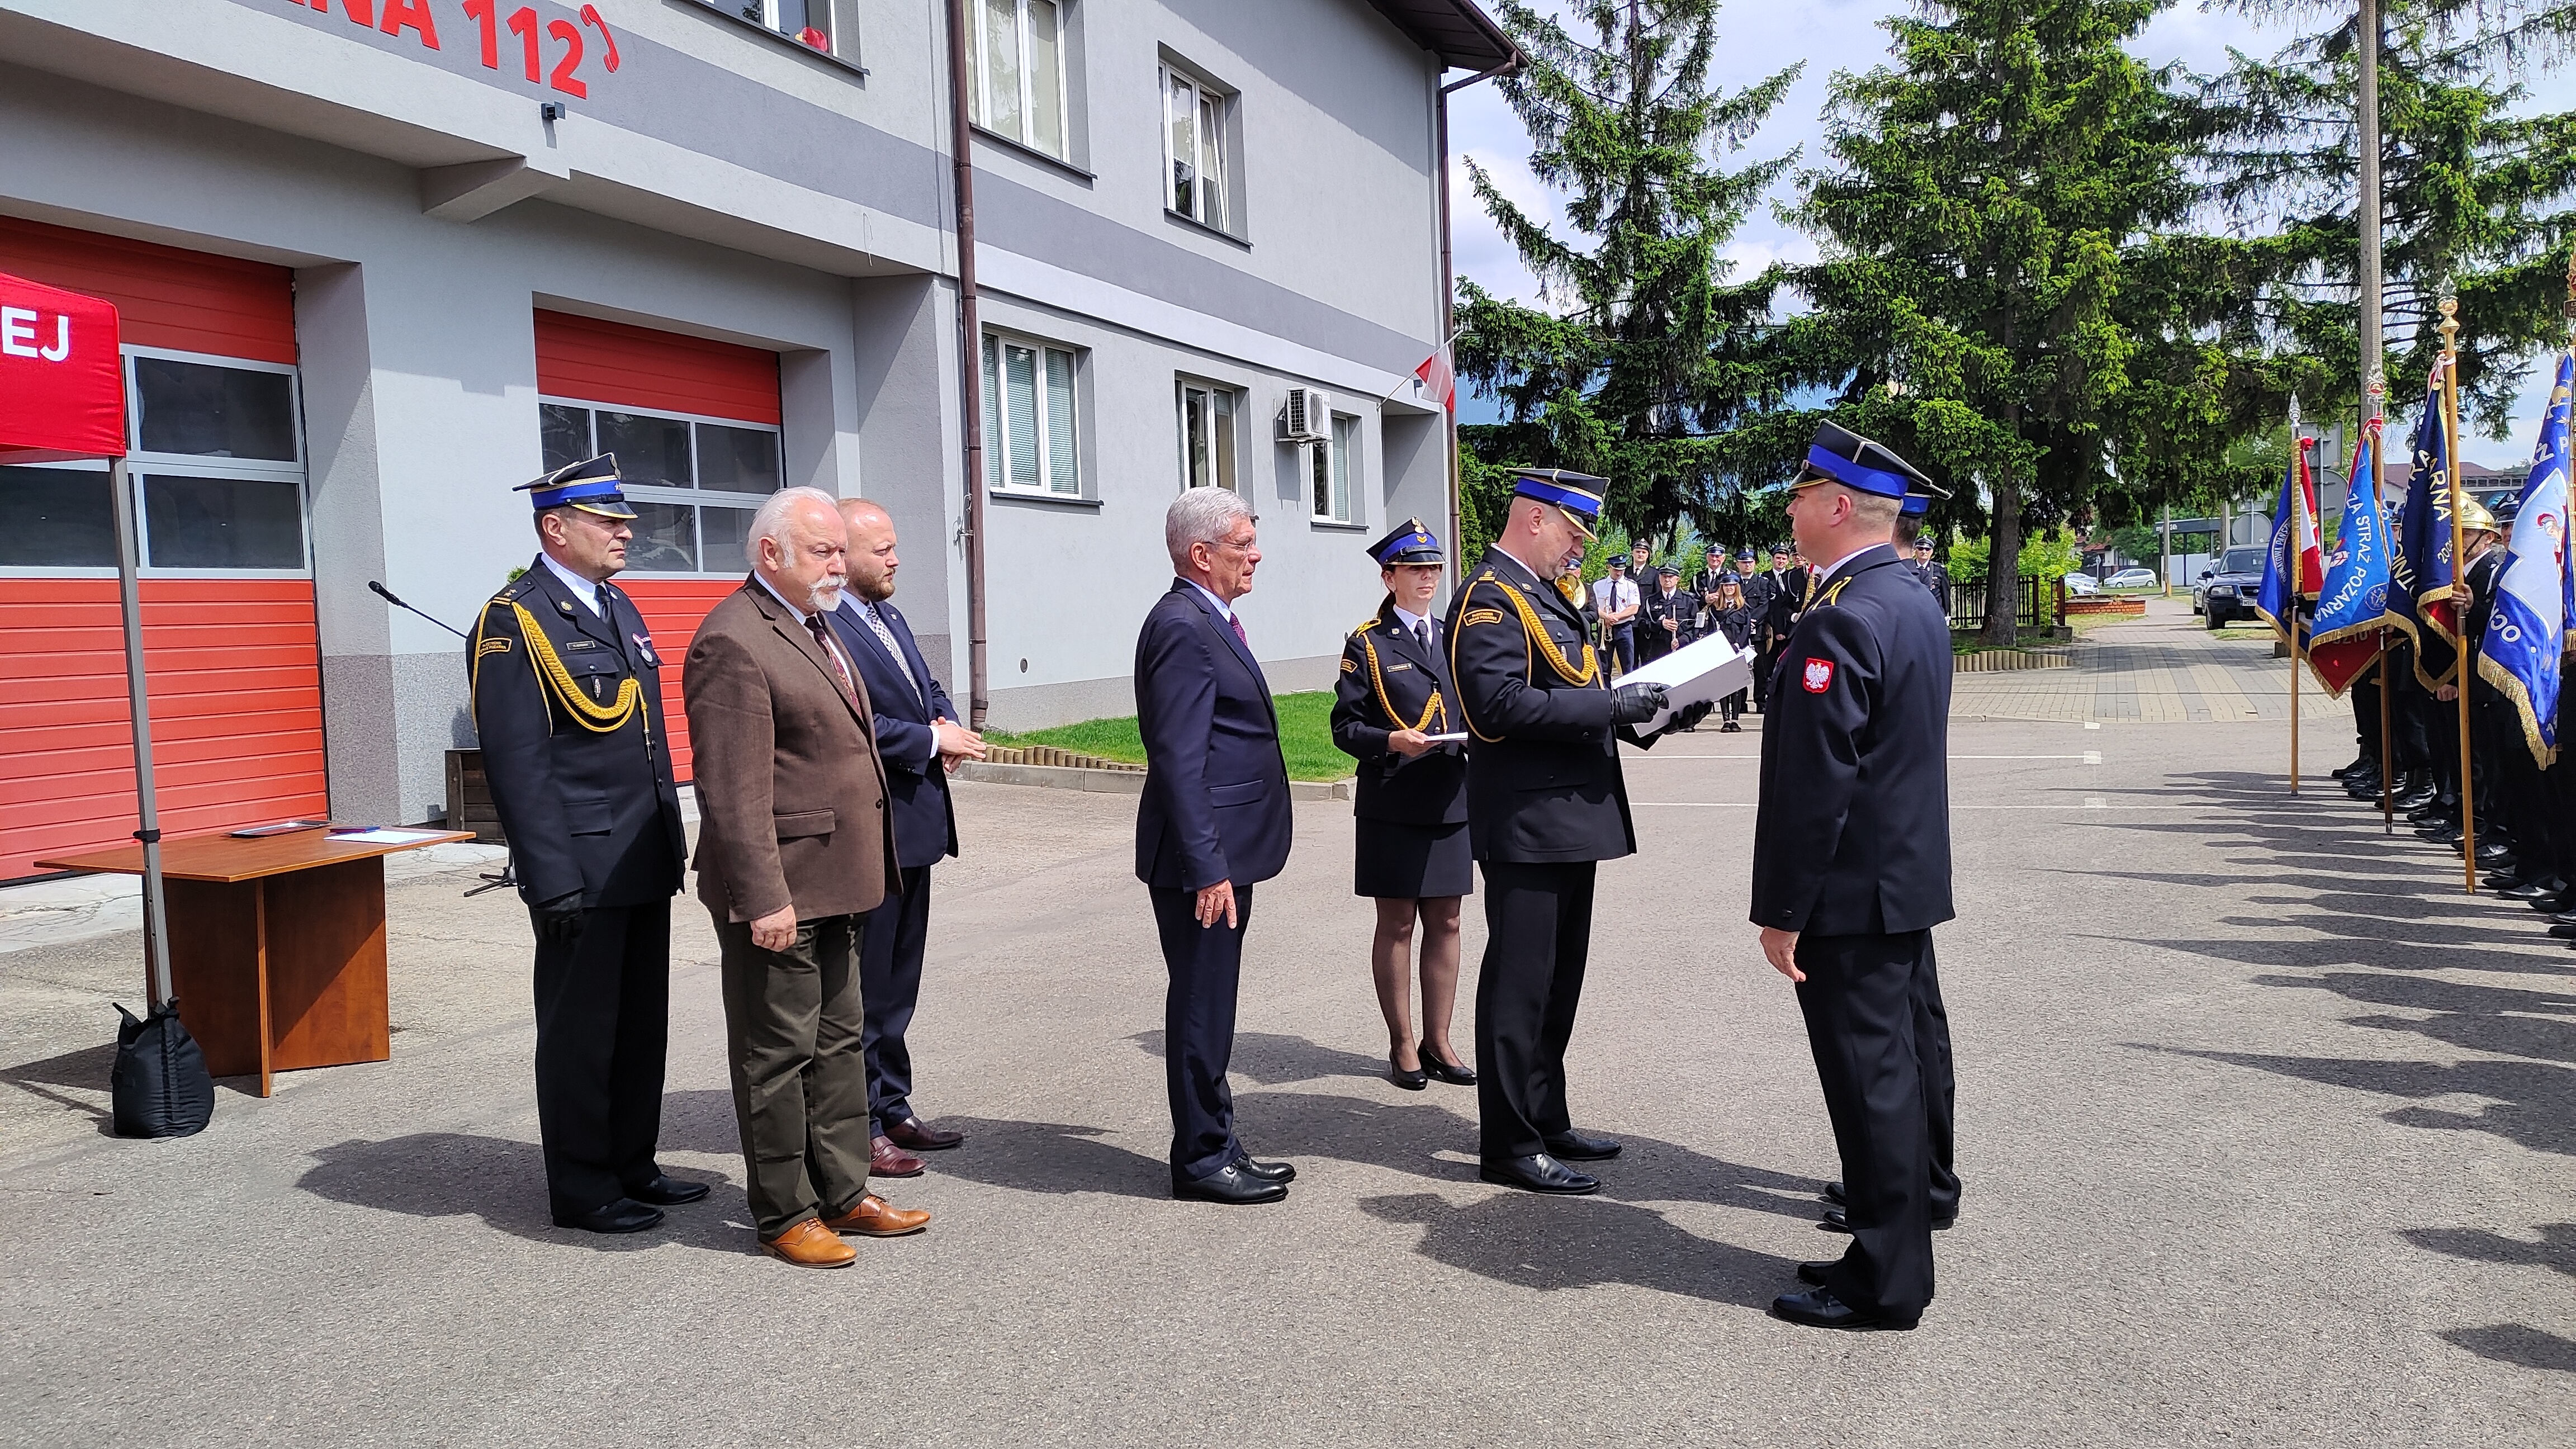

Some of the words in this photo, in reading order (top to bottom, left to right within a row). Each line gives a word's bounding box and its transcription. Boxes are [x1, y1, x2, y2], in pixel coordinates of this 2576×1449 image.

[462, 0, 587, 100] 112
[2, 306, 69, 361] EJ
[2275, 521, 2290, 546] PAŃST
[2356, 515, 2373, 564] STRAŻ
[2314, 565, 2367, 622] POŻARNA
